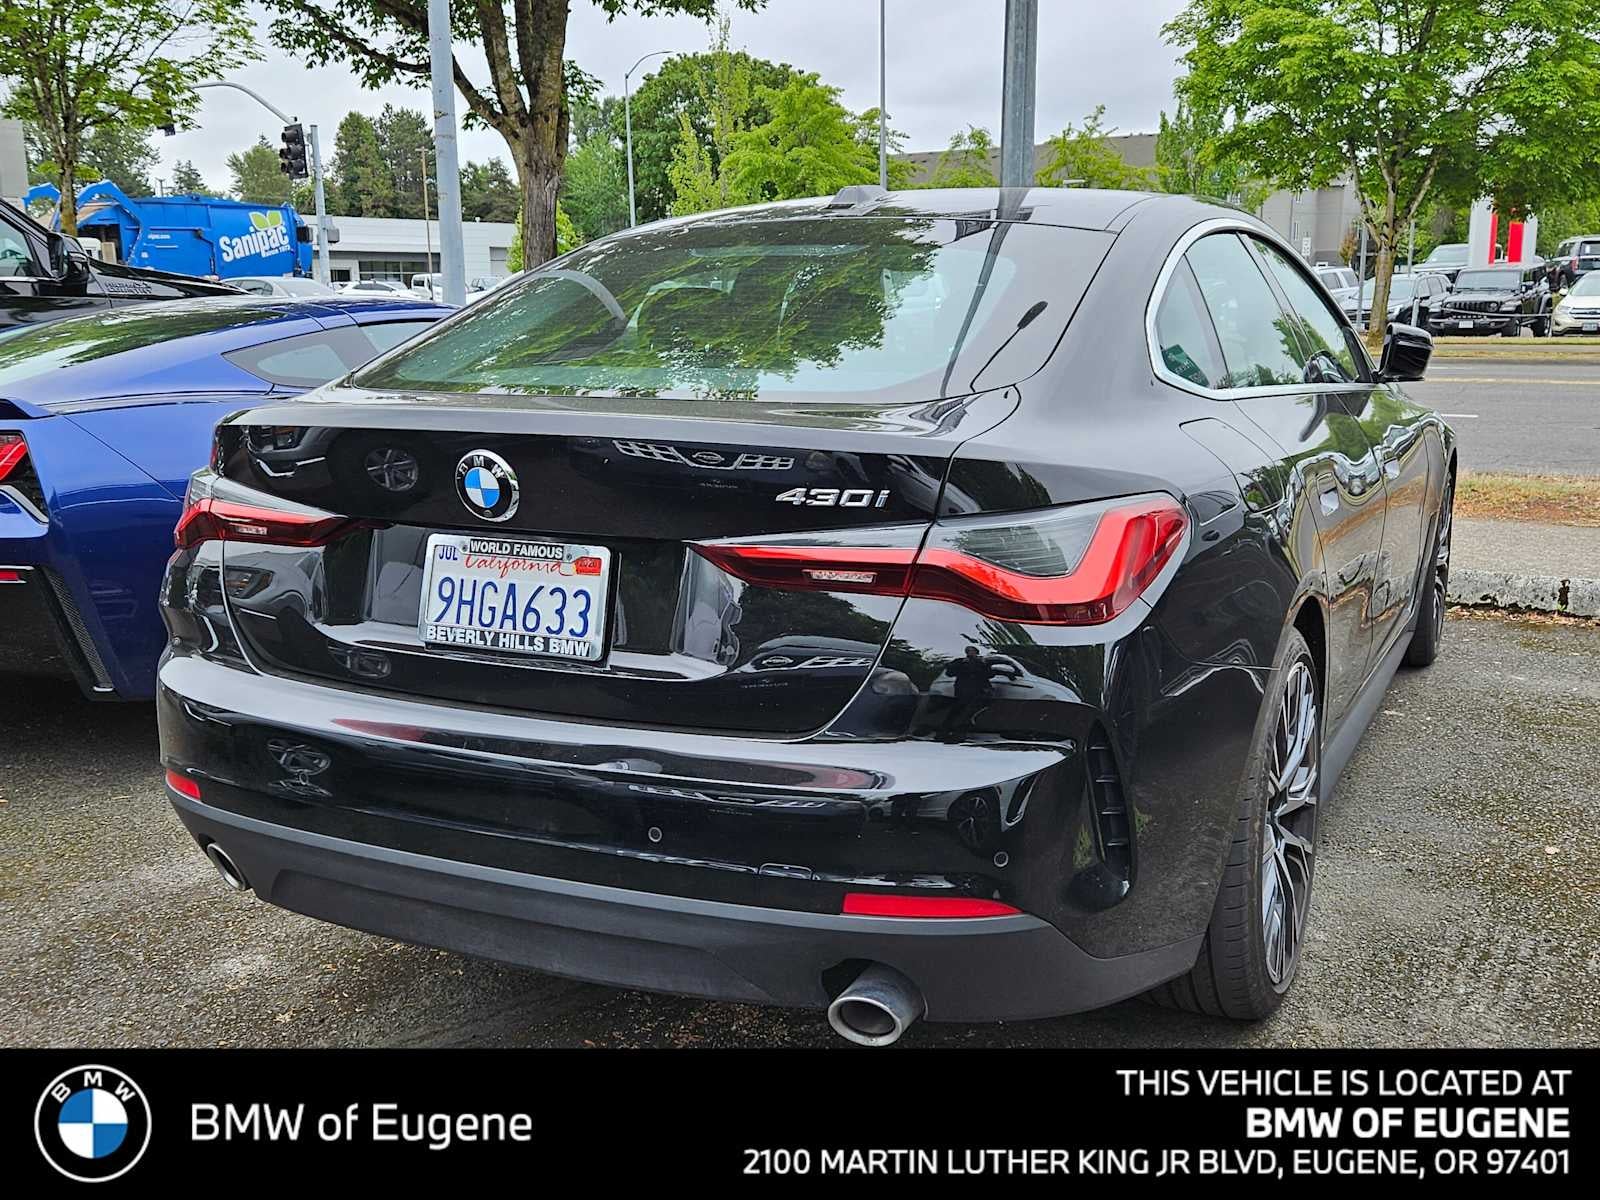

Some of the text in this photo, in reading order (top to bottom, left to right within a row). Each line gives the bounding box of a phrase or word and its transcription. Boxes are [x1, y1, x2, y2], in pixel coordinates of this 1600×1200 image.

[219, 226, 289, 262] Sanipac
[457, 455, 506, 479] BMW
[775, 487, 891, 508] 430i
[438, 546, 458, 561] JUL
[470, 540, 563, 560] WORLD FAMOUS
[464, 554, 574, 578] California
[434, 576, 592, 638] 9HGA633
[426, 626, 592, 658] BEVERLY HILLS BMW
